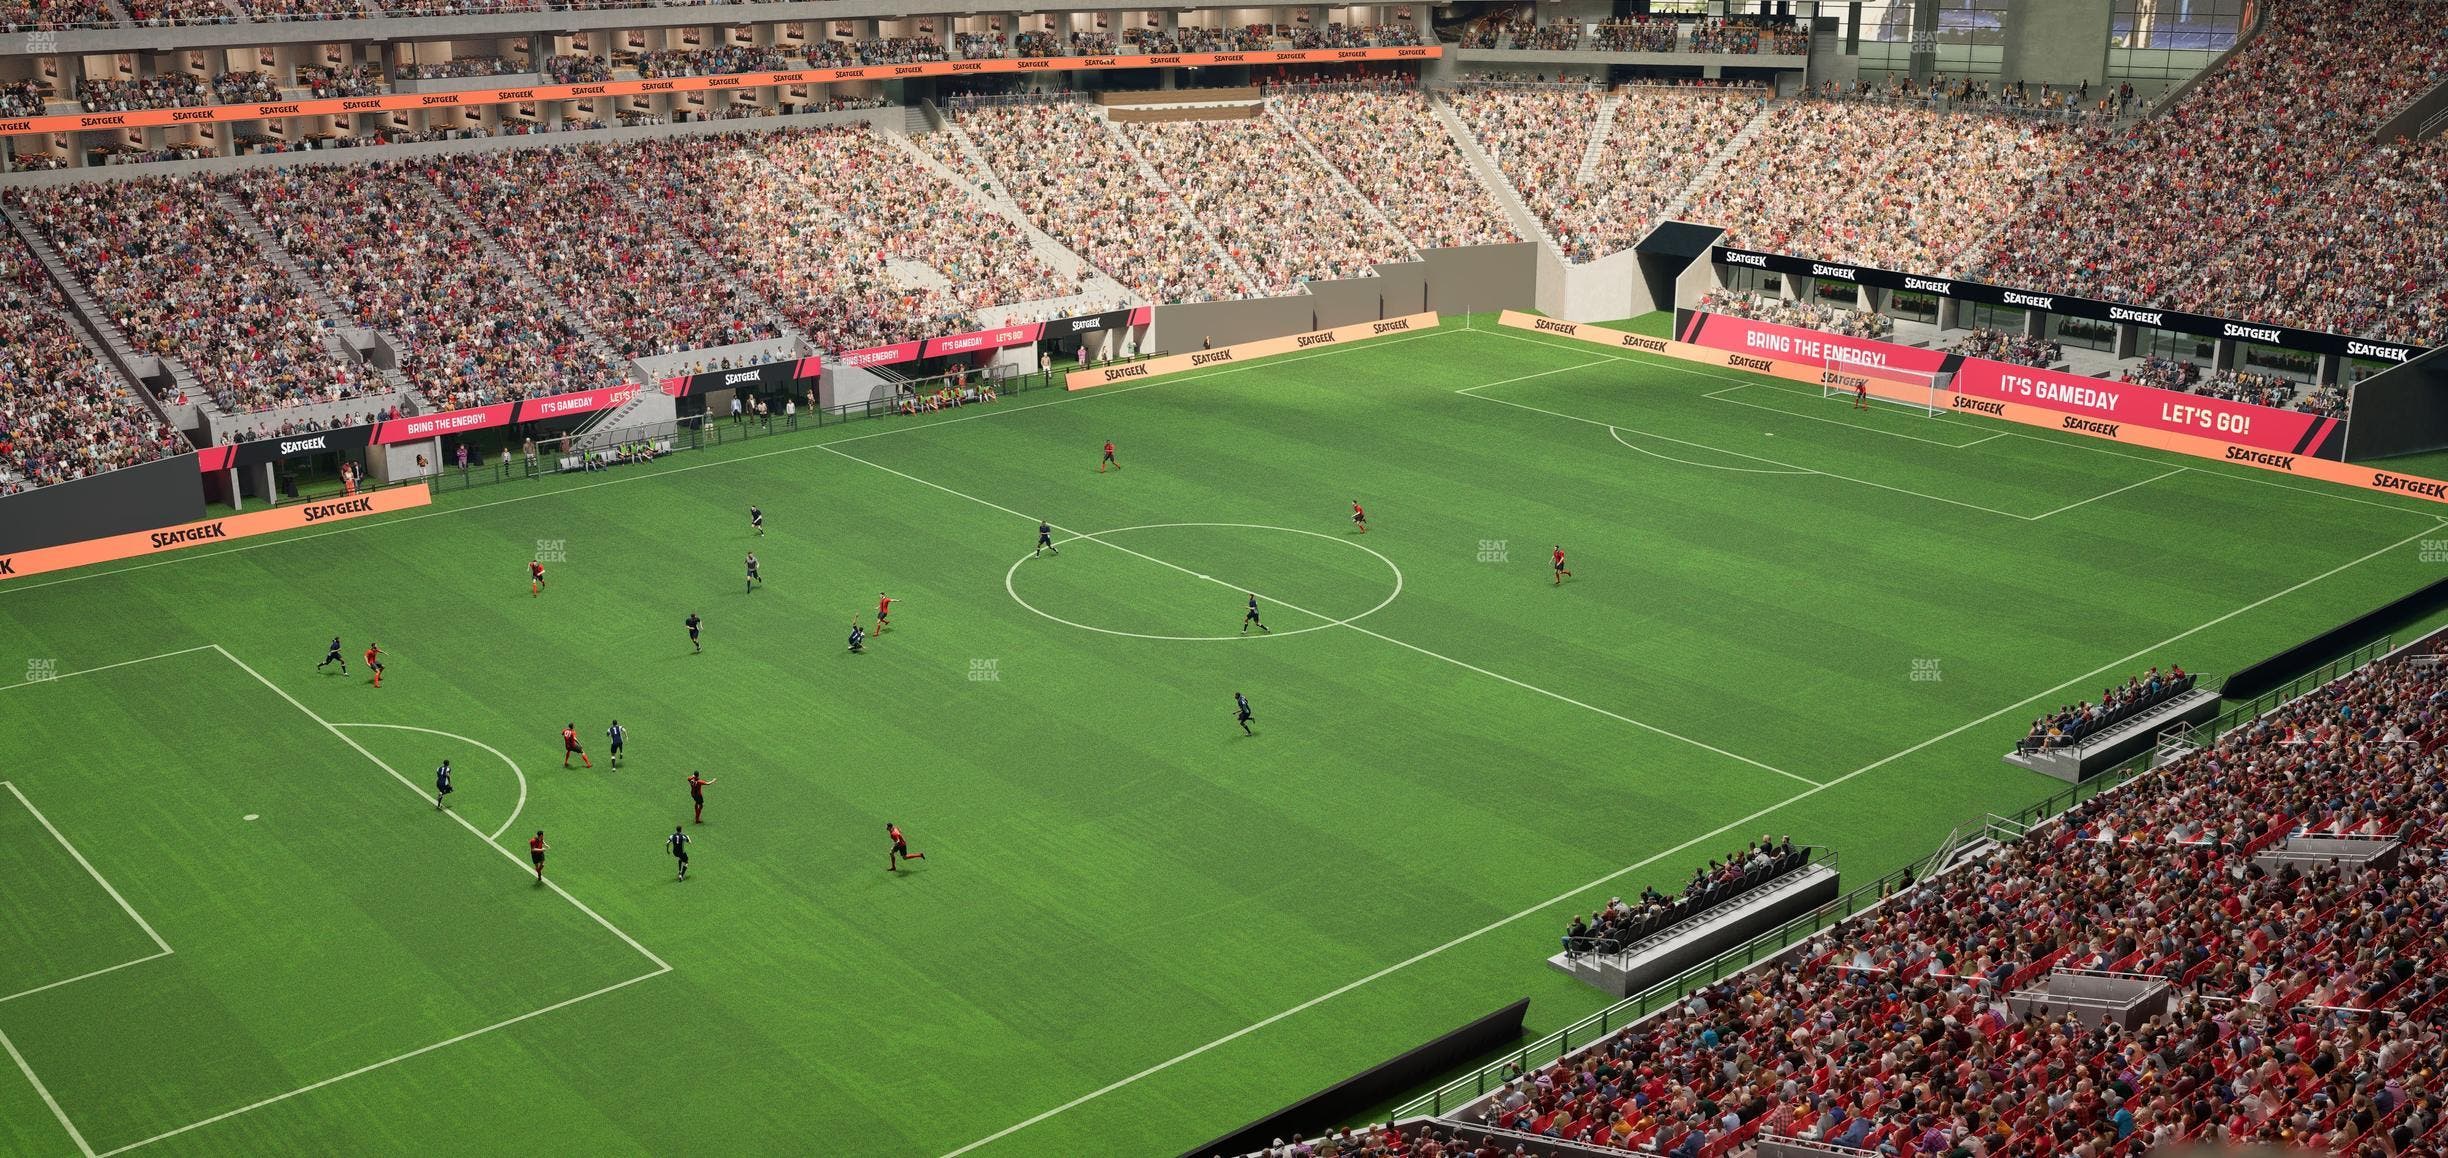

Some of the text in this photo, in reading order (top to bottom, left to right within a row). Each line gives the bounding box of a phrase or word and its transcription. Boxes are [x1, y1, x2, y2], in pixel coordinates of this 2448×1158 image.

[773, 74, 803, 84] SEATGEEK
[836, 69, 864, 79] SEATGEEK
[571, 85, 607, 96] SEATGEEK
[642, 78, 673, 89] SEATGEEK
[709, 78, 739, 88] SEATGEEK
[423, 94, 459, 104] SEATGEEK
[499, 90, 533, 100] SEATGEEK
[259, 104, 299, 115] SEATGEEK
[343, 99, 381, 110] SEATGEEK
[81, 113, 125, 126] SEATGEEK
[173, 110, 214, 121] SEATGEEK
[1726, 251, 1767, 268] SEATGEEK
[1812, 263, 1855, 281] SEATGEEK
[1904, 277, 1951, 295] SEATGEEK
[2003, 291, 2053, 310] SEATGEEK
[1072, 317, 1100, 331] SEATGEEK
[2109, 307, 2163, 326] SEATGEEK
[1373, 319, 1409, 334] SEATGEEK
[1535, 318, 1577, 336] SEATGEEK
[2224, 323, 2281, 343] SEATGEEK
[1297, 331, 1335, 347] SEATGEEK
[1622, 335, 1668, 352] SEATGEEK
[1191, 349, 1233, 366] SEATGEEK
[1747, 331, 1886, 367] BRING THE ENERGY!
[2347, 341, 2409, 362] SEATGEEK
[1104, 363, 1148, 381] SEATGEEK
[1728, 355, 1773, 372] SEATGEEK
[725, 369, 761, 386] SEATGEEK
[2001, 374, 2119, 411] IT'S GAMEDAY
[541, 396, 593, 413] IT'S GAMEDAY
[1952, 395, 2006, 416] SEATGEEK
[408, 413, 486, 434] BRING THE ENERGY!
[2062, 416, 2120, 437] SEATGEEK
[2162, 402, 2250, 435] LET'S GO!
[281, 435, 326, 455] SEATGEEK
[2225, 446, 2295, 470] SEATGEEK
[2372, 473, 2448, 499] SEATGEEK
[304, 497, 373, 521] SEATGEEK
[151, 522, 226, 548] SEATGEEK
